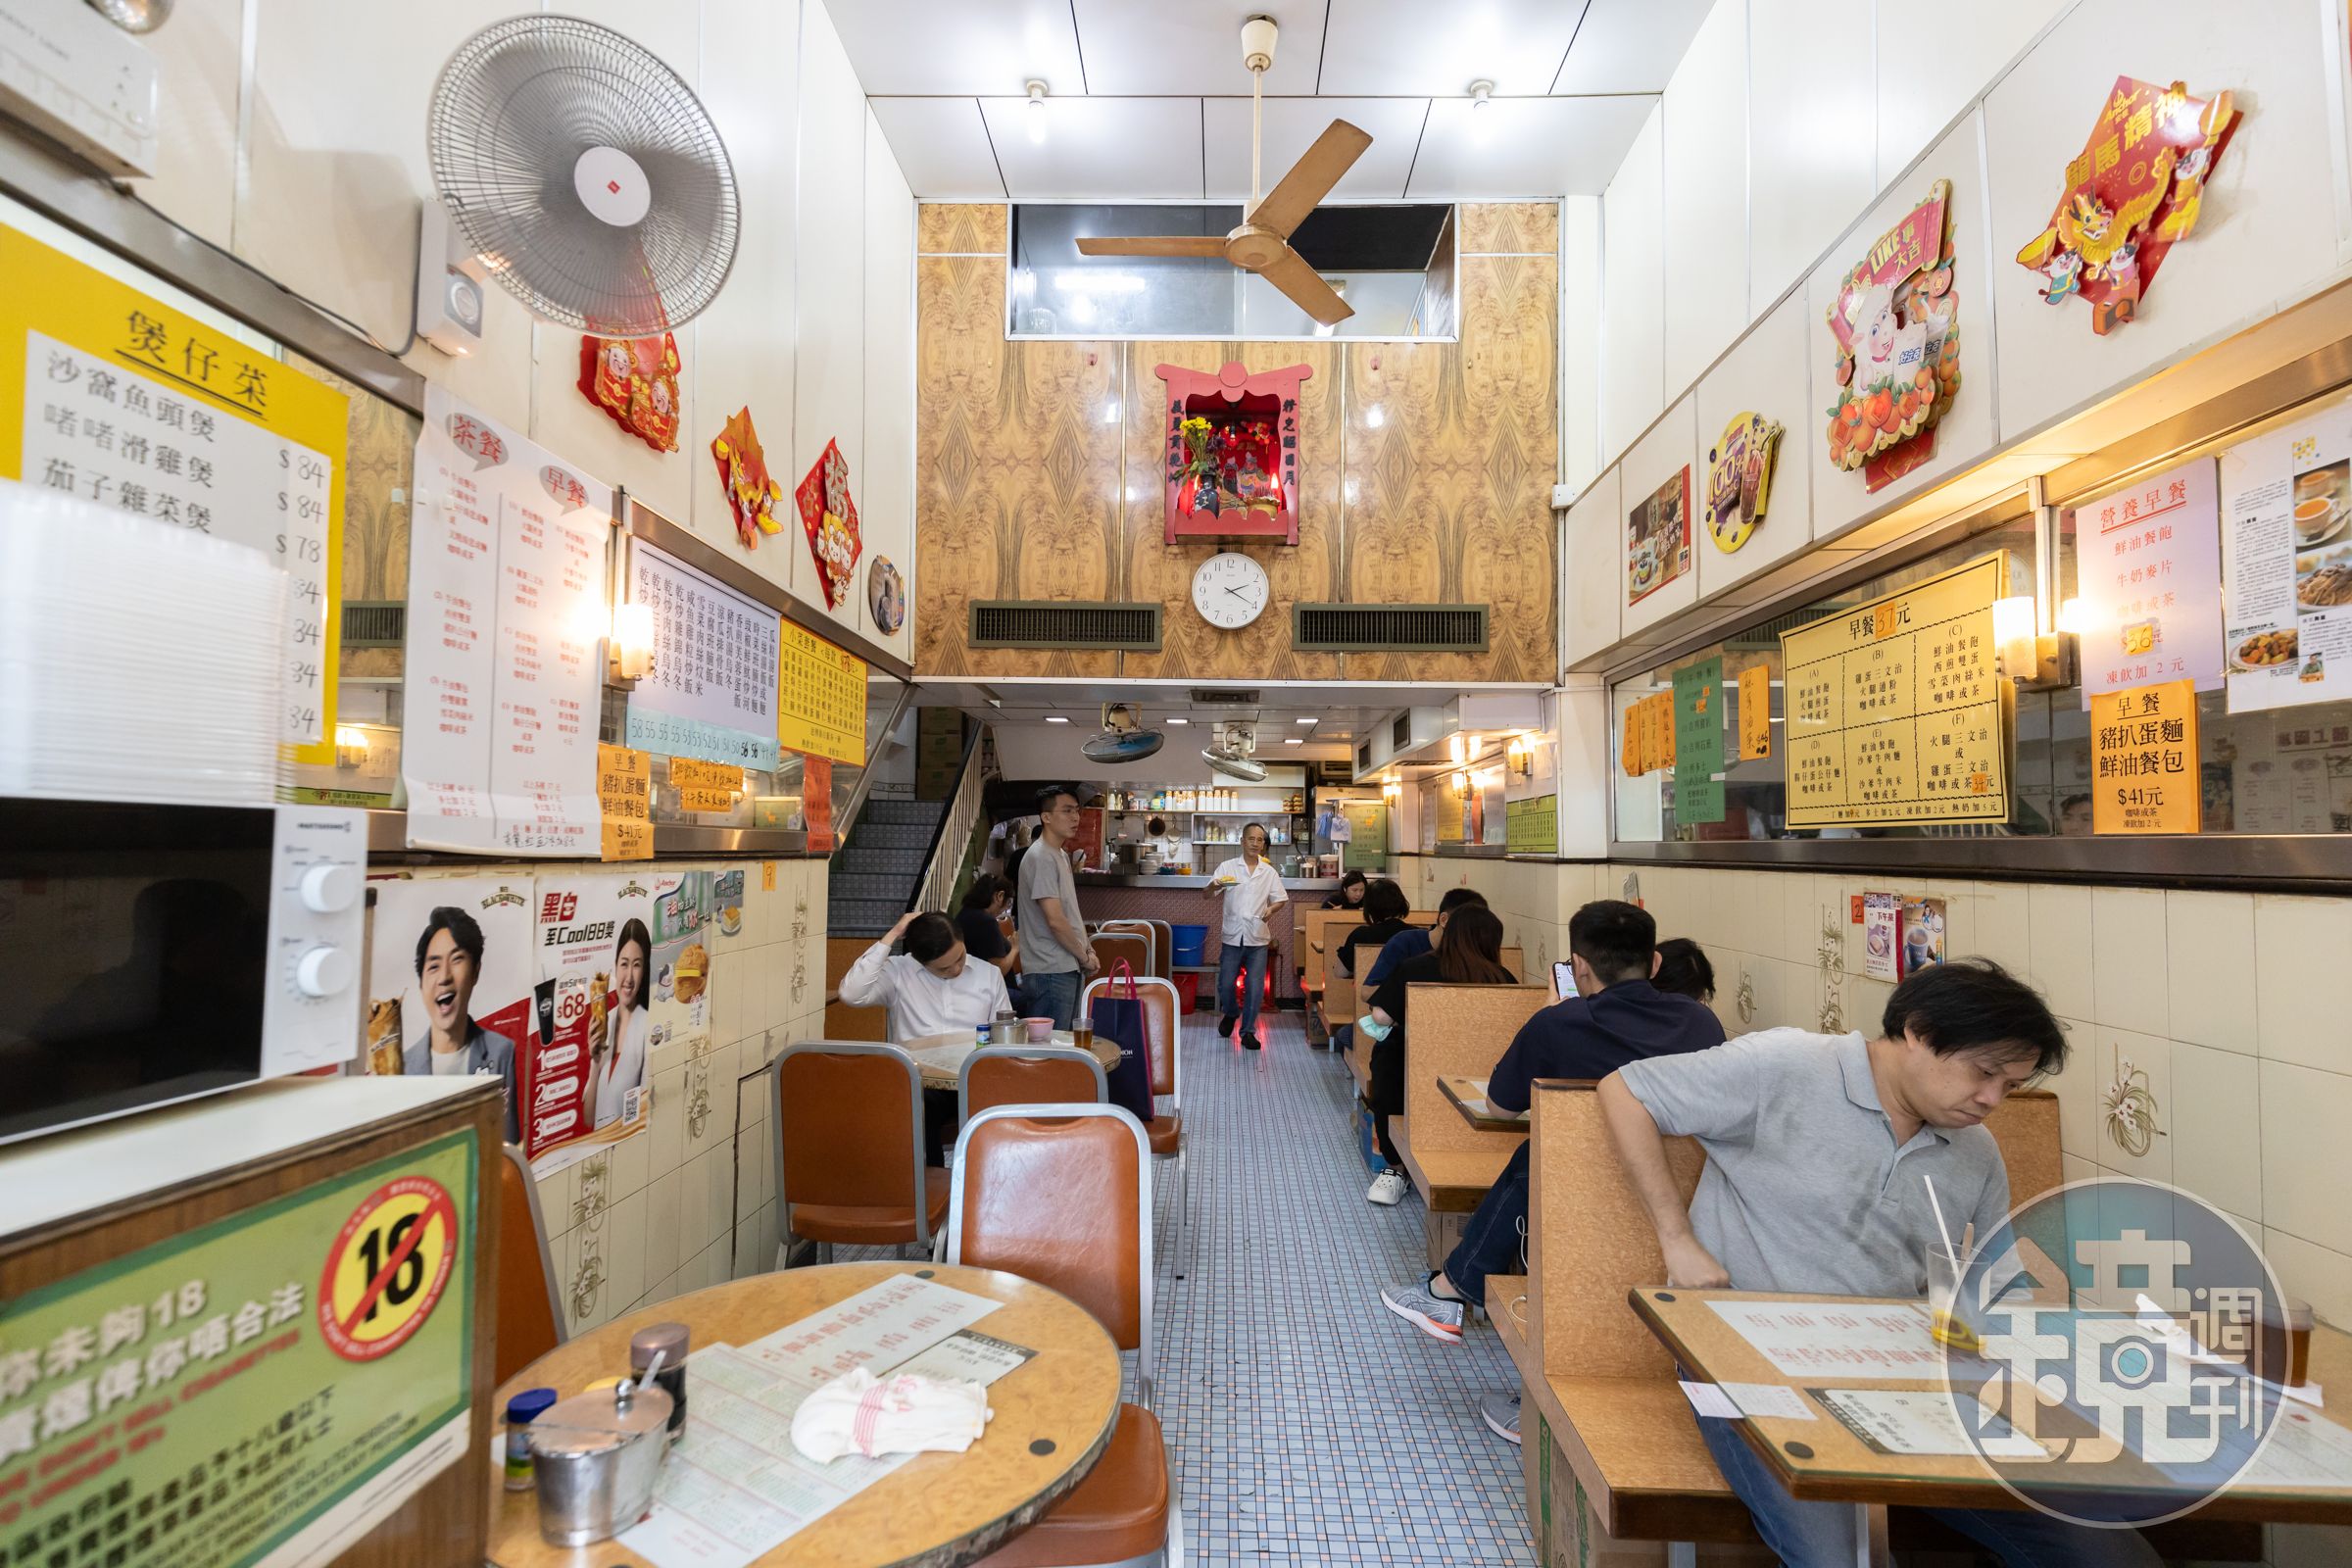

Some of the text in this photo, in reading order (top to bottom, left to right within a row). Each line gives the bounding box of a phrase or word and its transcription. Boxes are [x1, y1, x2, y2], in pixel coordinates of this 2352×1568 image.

[2066, 92, 2186, 191] 龍馬精神
[1870, 228, 1901, 275] LIKE
[454, 415, 502, 463] 茶餐
[547, 466, 586, 508] 早餐
[2100, 479, 2187, 525] 營養早餐
[2114, 524, 2173, 557] 鮮油餐飽
[1213, 562, 1221, 571] 11
[1226, 559, 1235, 568] 12
[2116, 560, 2173, 588] 牛奶麥片
[1202, 572, 1211, 582] 10
[2116, 592, 2176, 618] 咖啡或茶
[1949, 624, 1962, 638] (C)
[1873, 650, 1884, 661] (B)
[1934, 636, 1979, 658] 鮮油餐飽
[1934, 652, 1979, 672] 西煎雙蛋
[1855, 663, 1902, 684] 雞蛋三文治
[1929, 666, 1984, 690] 雪菜肉絲米
[1859, 679, 1896, 697] 火腿通粉
[1934, 685, 1980, 704] 咖啡或茶
[1859, 694, 1896, 710] 咖啡或茶
[2117, 693, 2160, 714] 早餐
[1951, 713, 1965, 726] (F)
[1930, 728, 1987, 748] 火腿三文治
[2098, 717, 2184, 751] 豬扒蛋麵
[741, 743, 749, 759] 56
[751, 743, 759, 759] 56
[1955, 748, 1964, 759] 或
[615, 753, 636, 771] 早餐
[1876, 766, 1883, 775] 或
[1931, 760, 1988, 777] 雞蛋三文治
[2098, 749, 2184, 778] 鮮油餐包
[603, 774, 646, 797] 豬扒蛋麵
[1863, 789, 1898, 800] 咖啡或茶
[603, 796, 645, 818] 鮮油餐包
[2118, 786, 2164, 808] $41元
[1906, 804, 1945, 815] 凍飲加2元
[1952, 802, 1997, 814] 熱奶加5元
[2125, 808, 2158, 818] 咖啡或茶
[766, 866, 772, 887] 9
[540, 892, 578, 924] 黑白
[1854, 904, 1862, 918] 2
[557, 992, 585, 1019] $68
[536, 1049, 546, 1071] 1
[535, 1083, 546, 1106] 2
[533, 1117, 544, 1142] 3
[359, 1212, 424, 1324] 18
